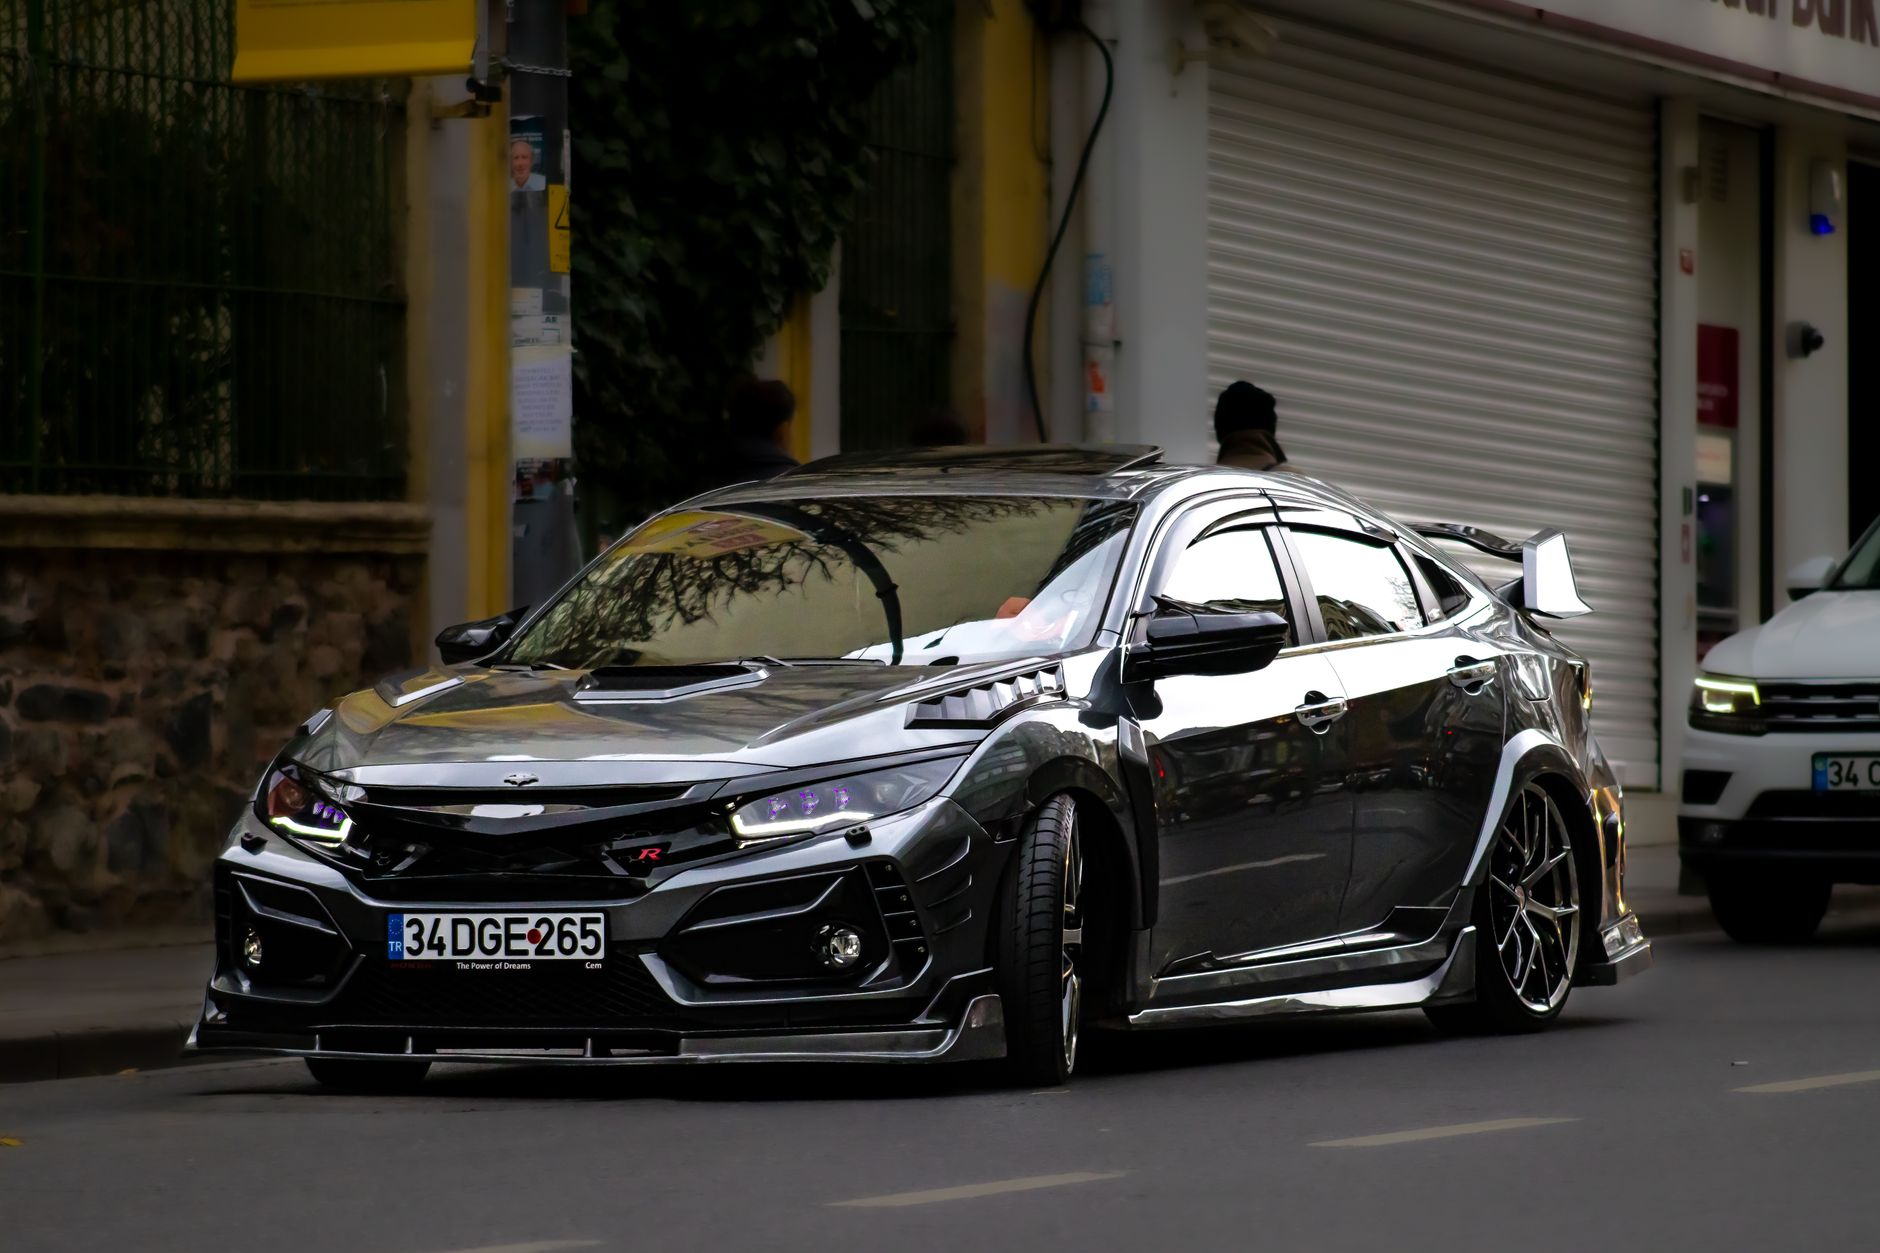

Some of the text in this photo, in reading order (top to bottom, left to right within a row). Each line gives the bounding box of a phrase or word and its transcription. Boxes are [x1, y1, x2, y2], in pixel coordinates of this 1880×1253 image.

[1829, 760, 1859, 787] 34
[639, 848, 662, 860] R
[388, 941, 402, 952] TR
[456, 962, 531, 970] The Power of Dreams
[585, 961, 602, 969] Cem
